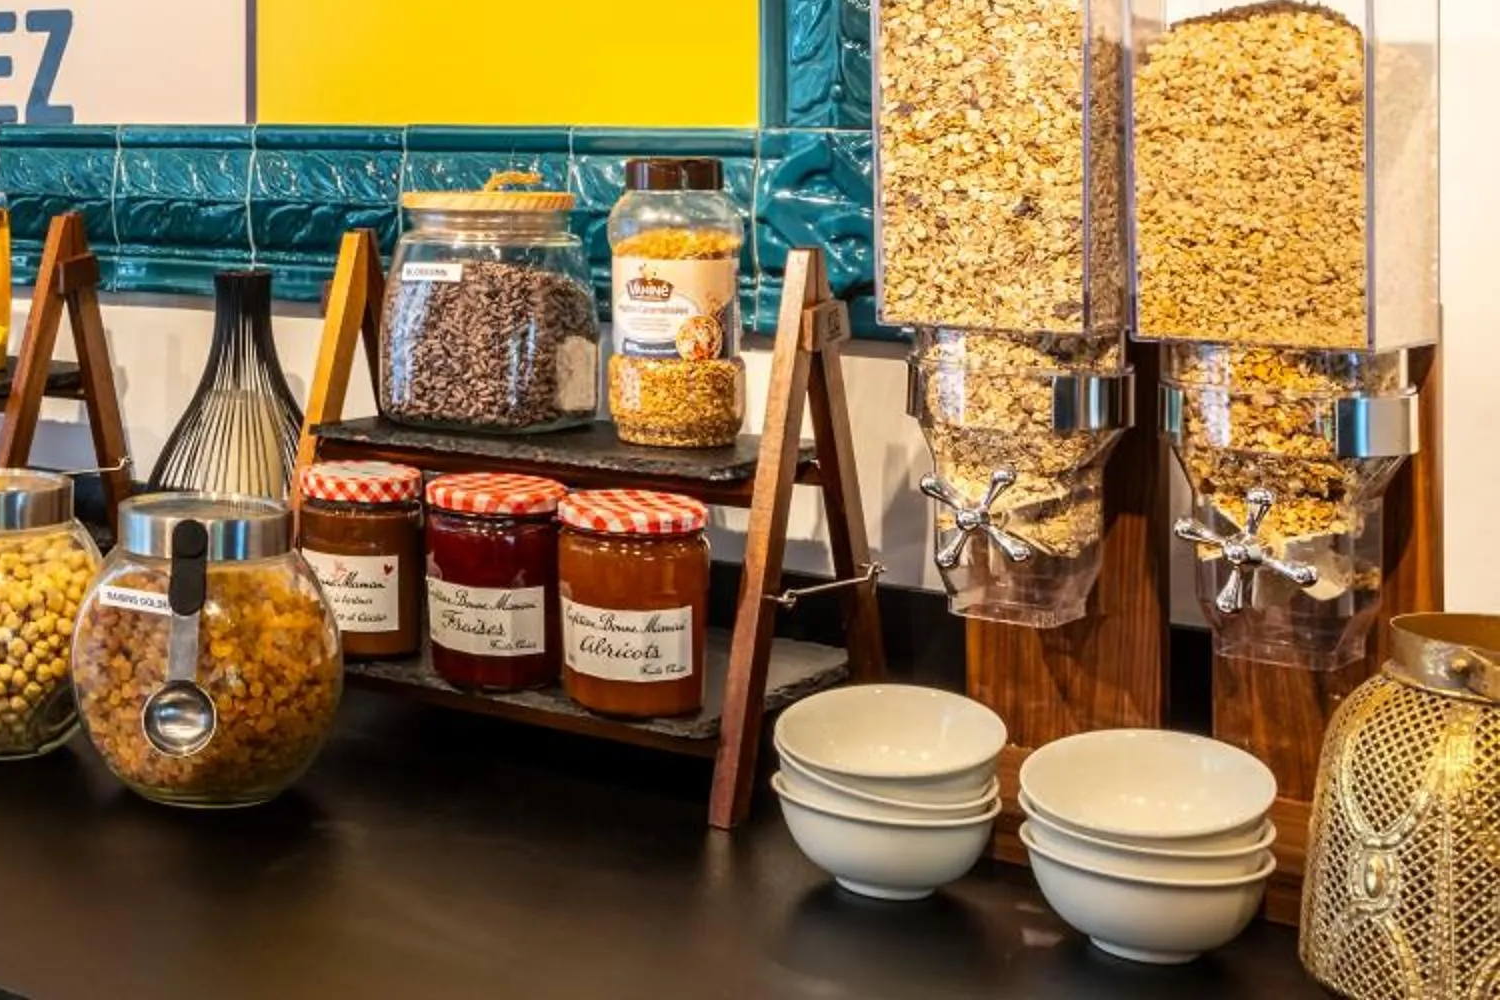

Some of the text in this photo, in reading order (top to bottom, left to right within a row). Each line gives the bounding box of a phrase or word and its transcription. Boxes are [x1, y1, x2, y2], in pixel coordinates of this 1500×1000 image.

[455, 589, 488, 609] Bonne
[441, 609, 506, 637] Fraises
[599, 612, 639, 633] Bonne
[579, 635, 662, 661] Abricots
